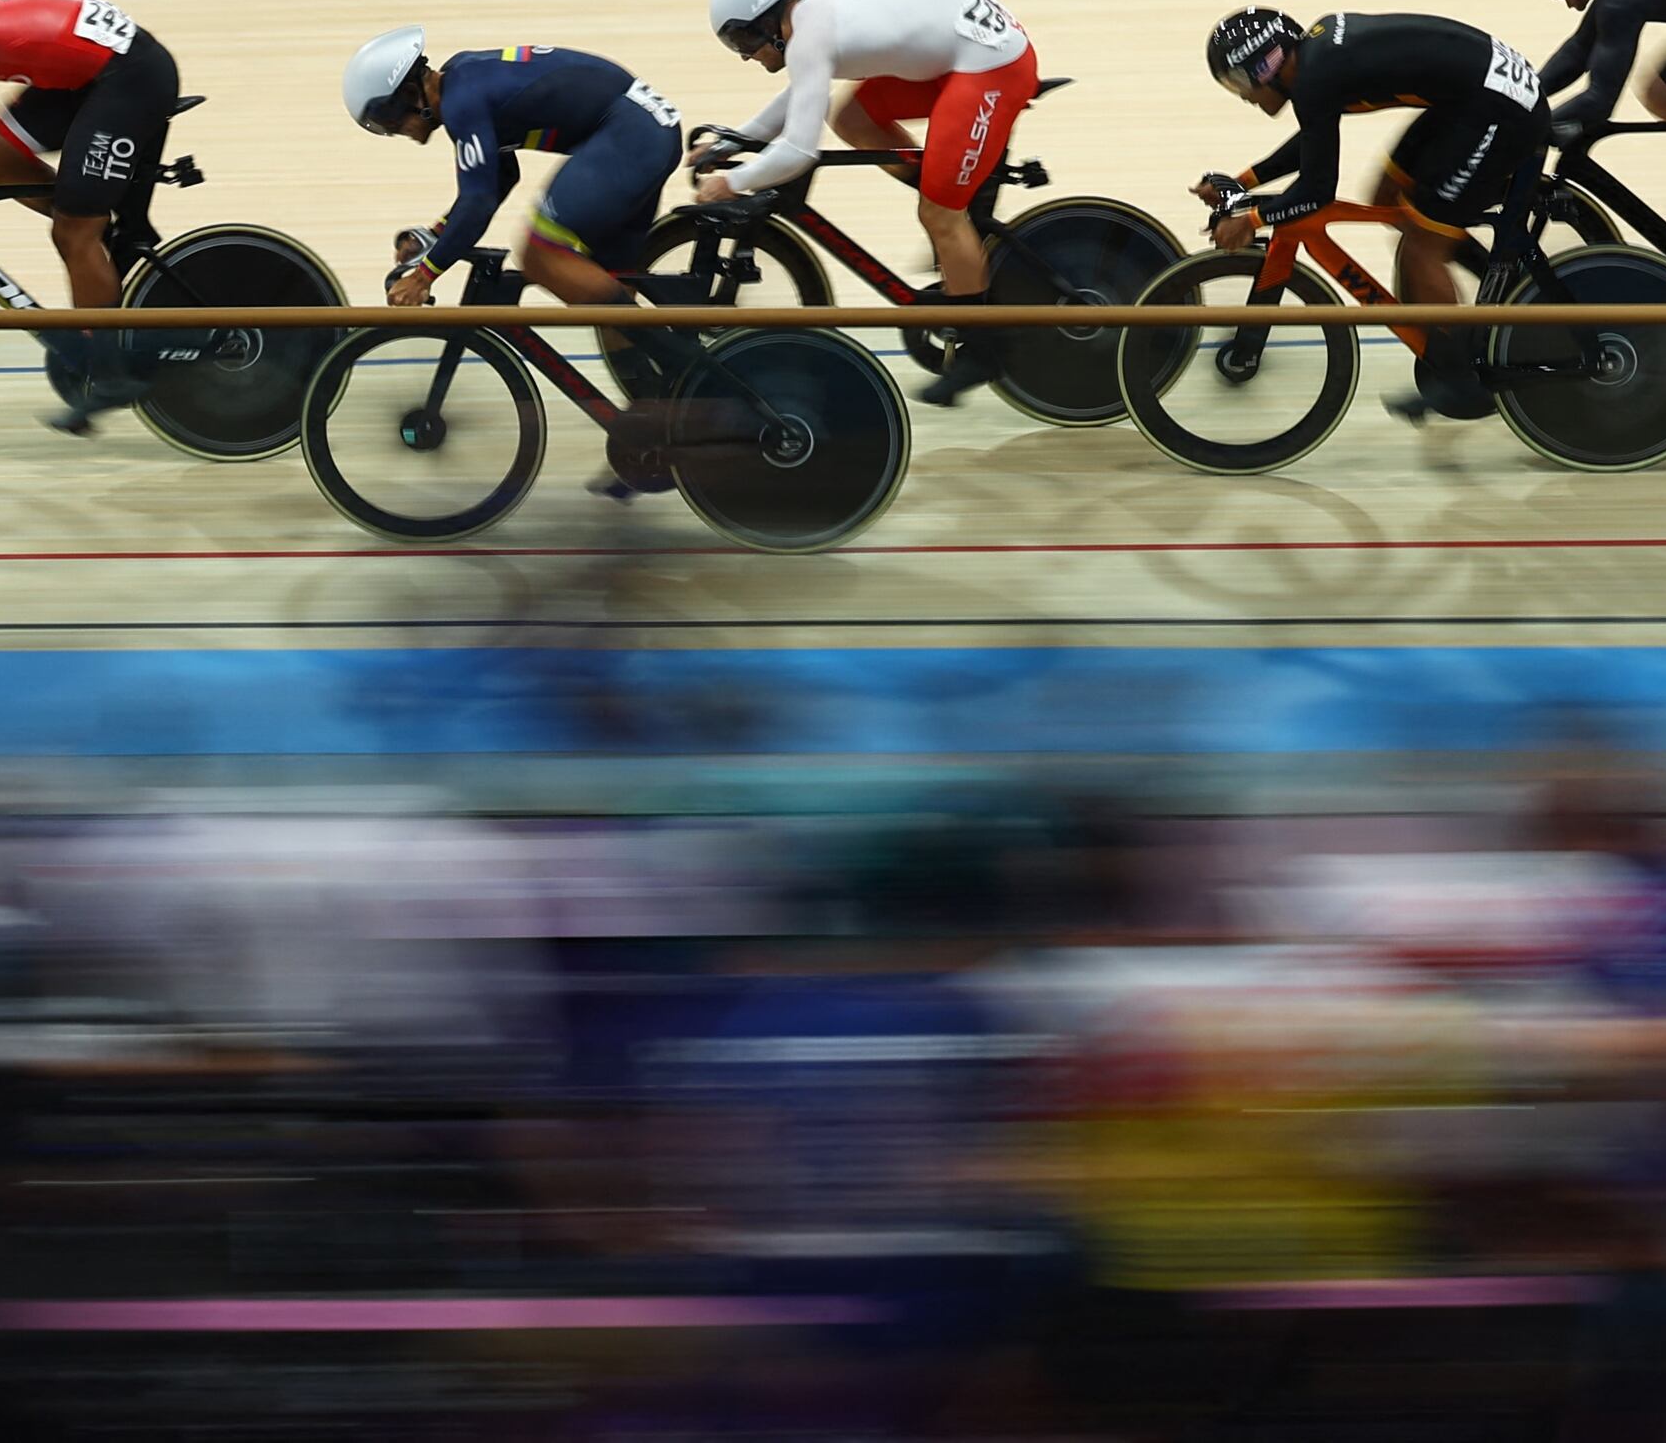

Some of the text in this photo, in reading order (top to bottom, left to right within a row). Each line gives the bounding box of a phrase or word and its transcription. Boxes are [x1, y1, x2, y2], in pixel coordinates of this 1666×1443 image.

[85, 2, 129, 38] 242
[82, 131, 113, 177] TEAM
[103, 138, 135, 180] TTO
[957, 90, 1002, 186] POLSKA
